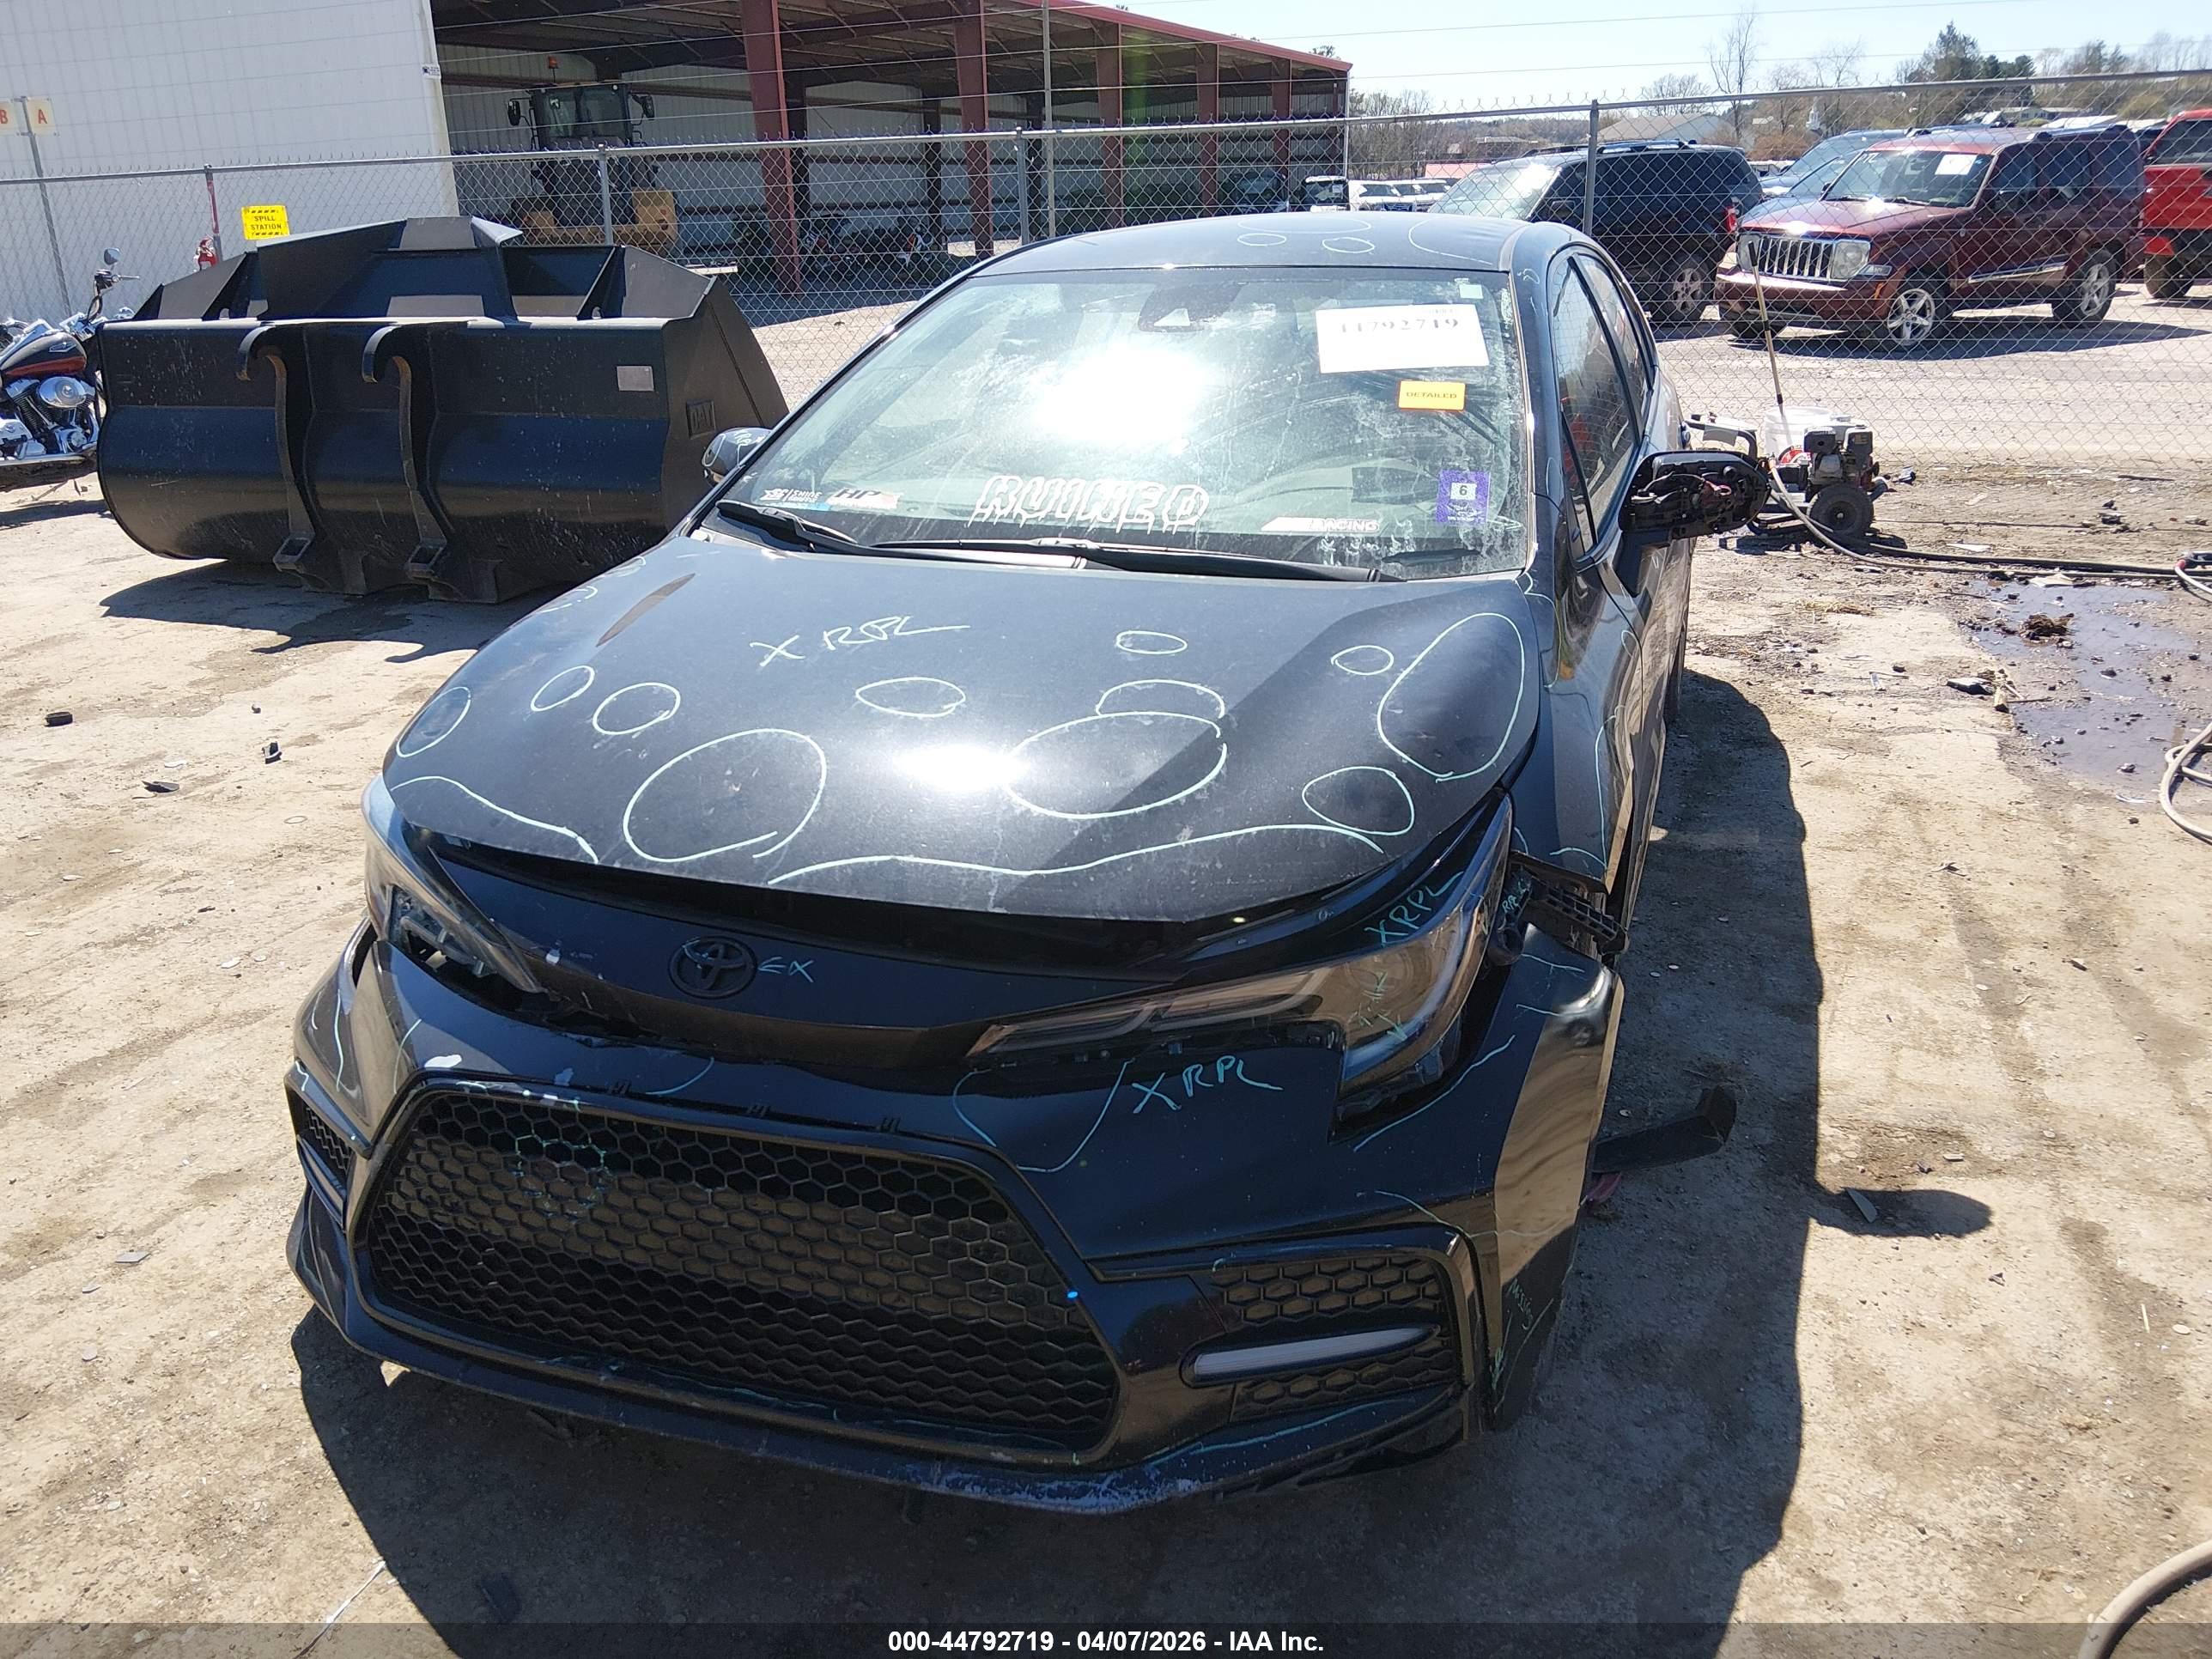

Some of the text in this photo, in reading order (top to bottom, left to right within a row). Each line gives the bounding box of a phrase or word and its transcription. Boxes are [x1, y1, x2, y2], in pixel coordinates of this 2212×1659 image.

[0, 109, 9, 125] B
[38, 109, 48, 125] A
[1406, 391, 1458, 399] DETAILED
[1458, 484, 1468, 496] 6
